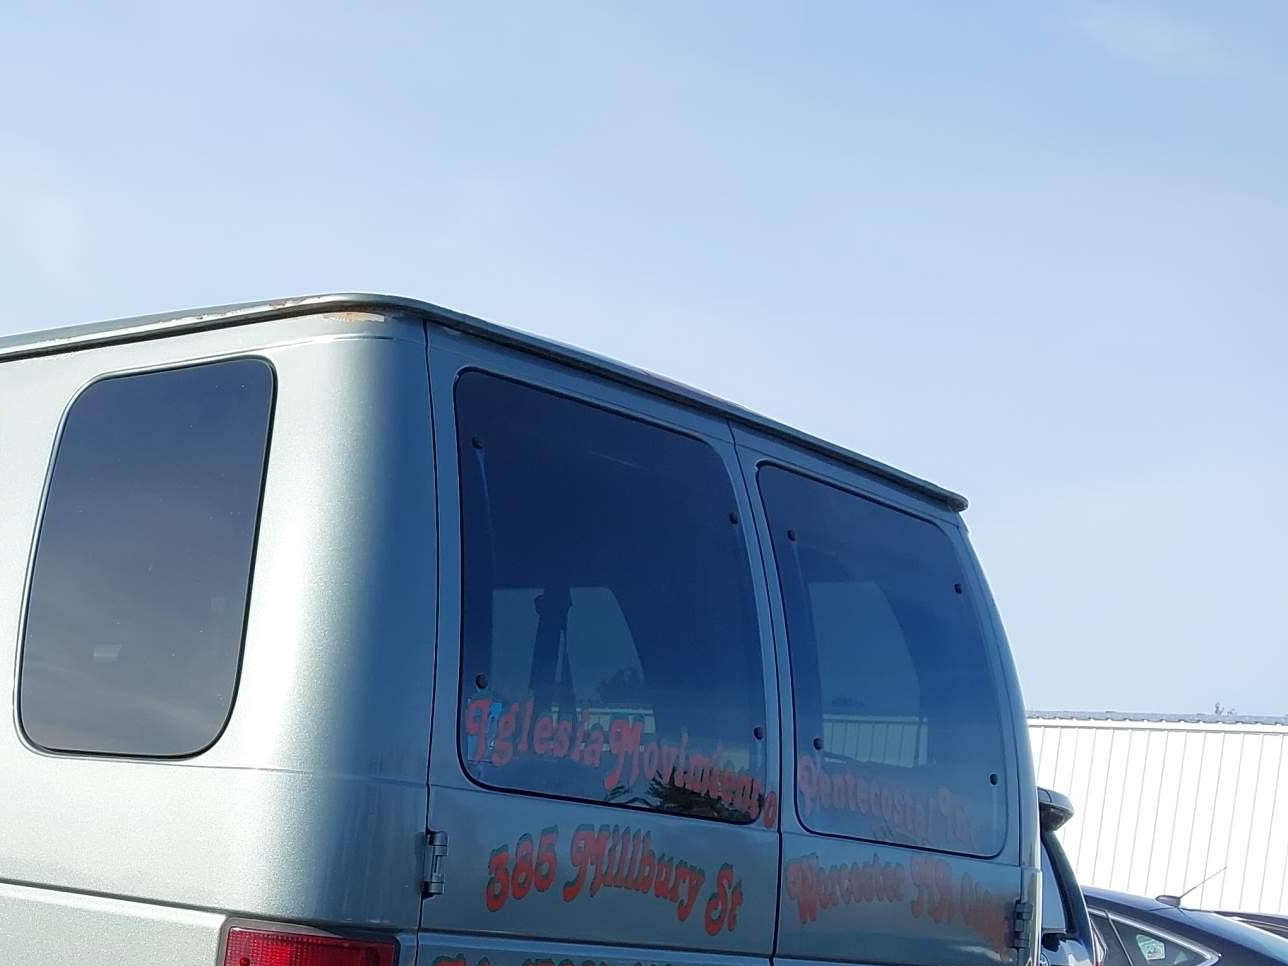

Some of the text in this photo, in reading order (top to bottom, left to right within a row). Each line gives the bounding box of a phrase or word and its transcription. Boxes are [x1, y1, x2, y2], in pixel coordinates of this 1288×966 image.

[465, 697, 601, 769] Iglesia
[486, 824, 743, 936] 385 Millbury St
